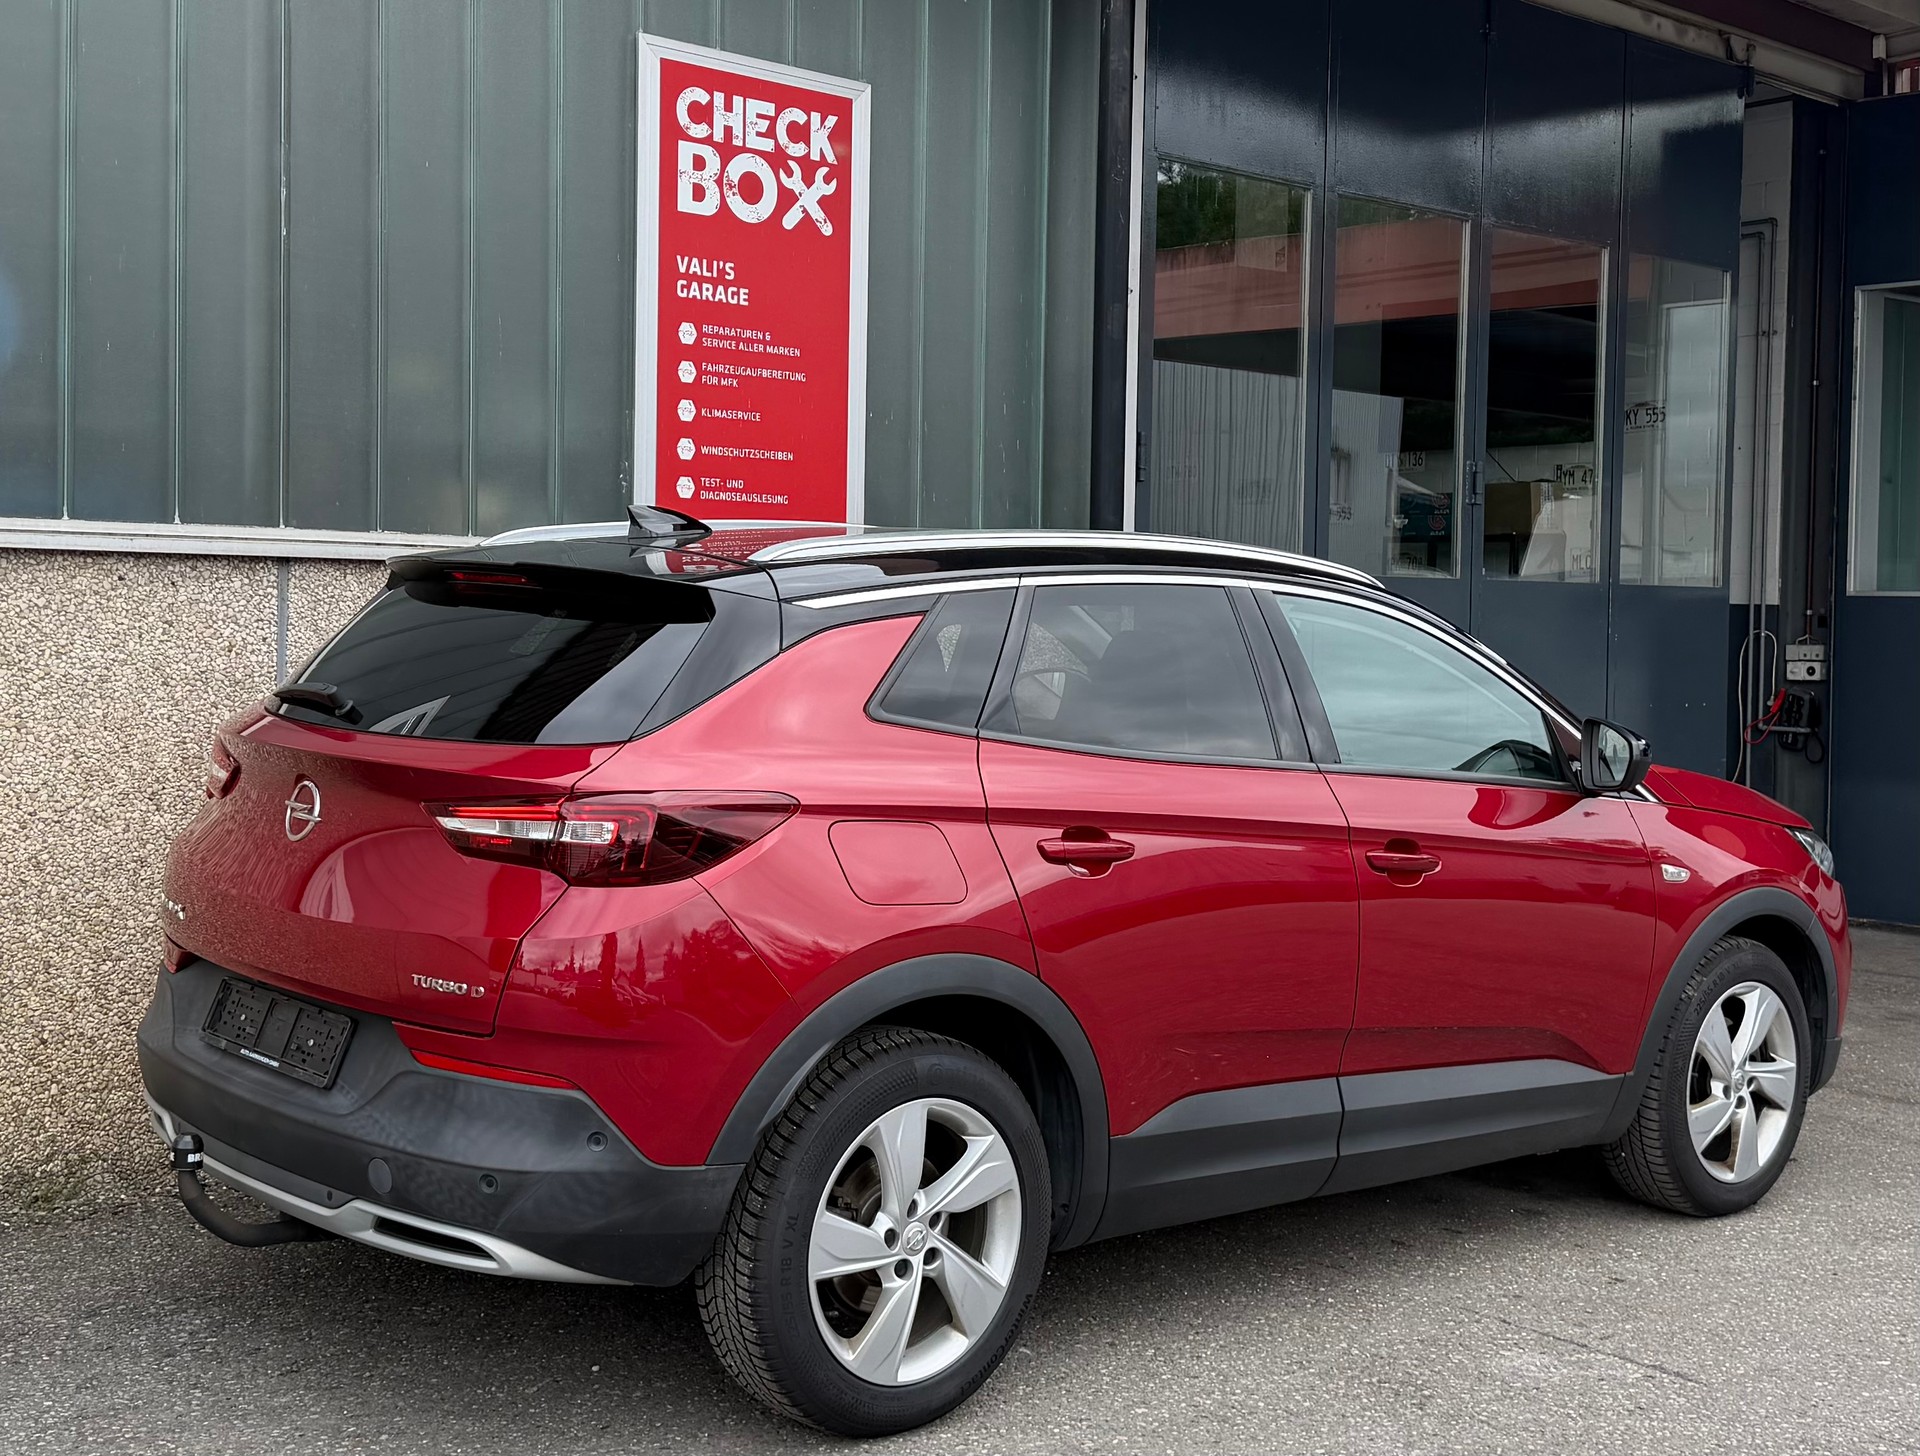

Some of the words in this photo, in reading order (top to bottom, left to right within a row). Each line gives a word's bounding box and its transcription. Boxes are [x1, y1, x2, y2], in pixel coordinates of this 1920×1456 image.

[676, 86, 838, 165] CHECK
[677, 139, 837, 236] BOX
[676, 254, 735, 280] VALI'S
[676, 279, 749, 306] GARAGE
[702, 324, 763, 340] REPARATUREN
[702, 337, 736, 350] SERVICE
[738, 339, 764, 353] ALLER
[766, 344, 801, 357] MARKEN
[701, 374, 718, 386] FÜR
[720, 377, 739, 388] MFK
[702, 362, 806, 382] FAHRZEUGAUFBEREITUNG
[701, 407, 761, 422] KLIMASERVICE
[700, 445, 793, 461] WINDSCHUTZSCHEIBEN
[700, 477, 724, 488] TEST-
[726, 479, 744, 489] UND
[700, 490, 789, 505] DIAGNOSEAUSLESUNG
[411, 973, 468, 995] TURBO
[470, 985, 485, 998] D
[785, 1212, 800, 1232] XL
